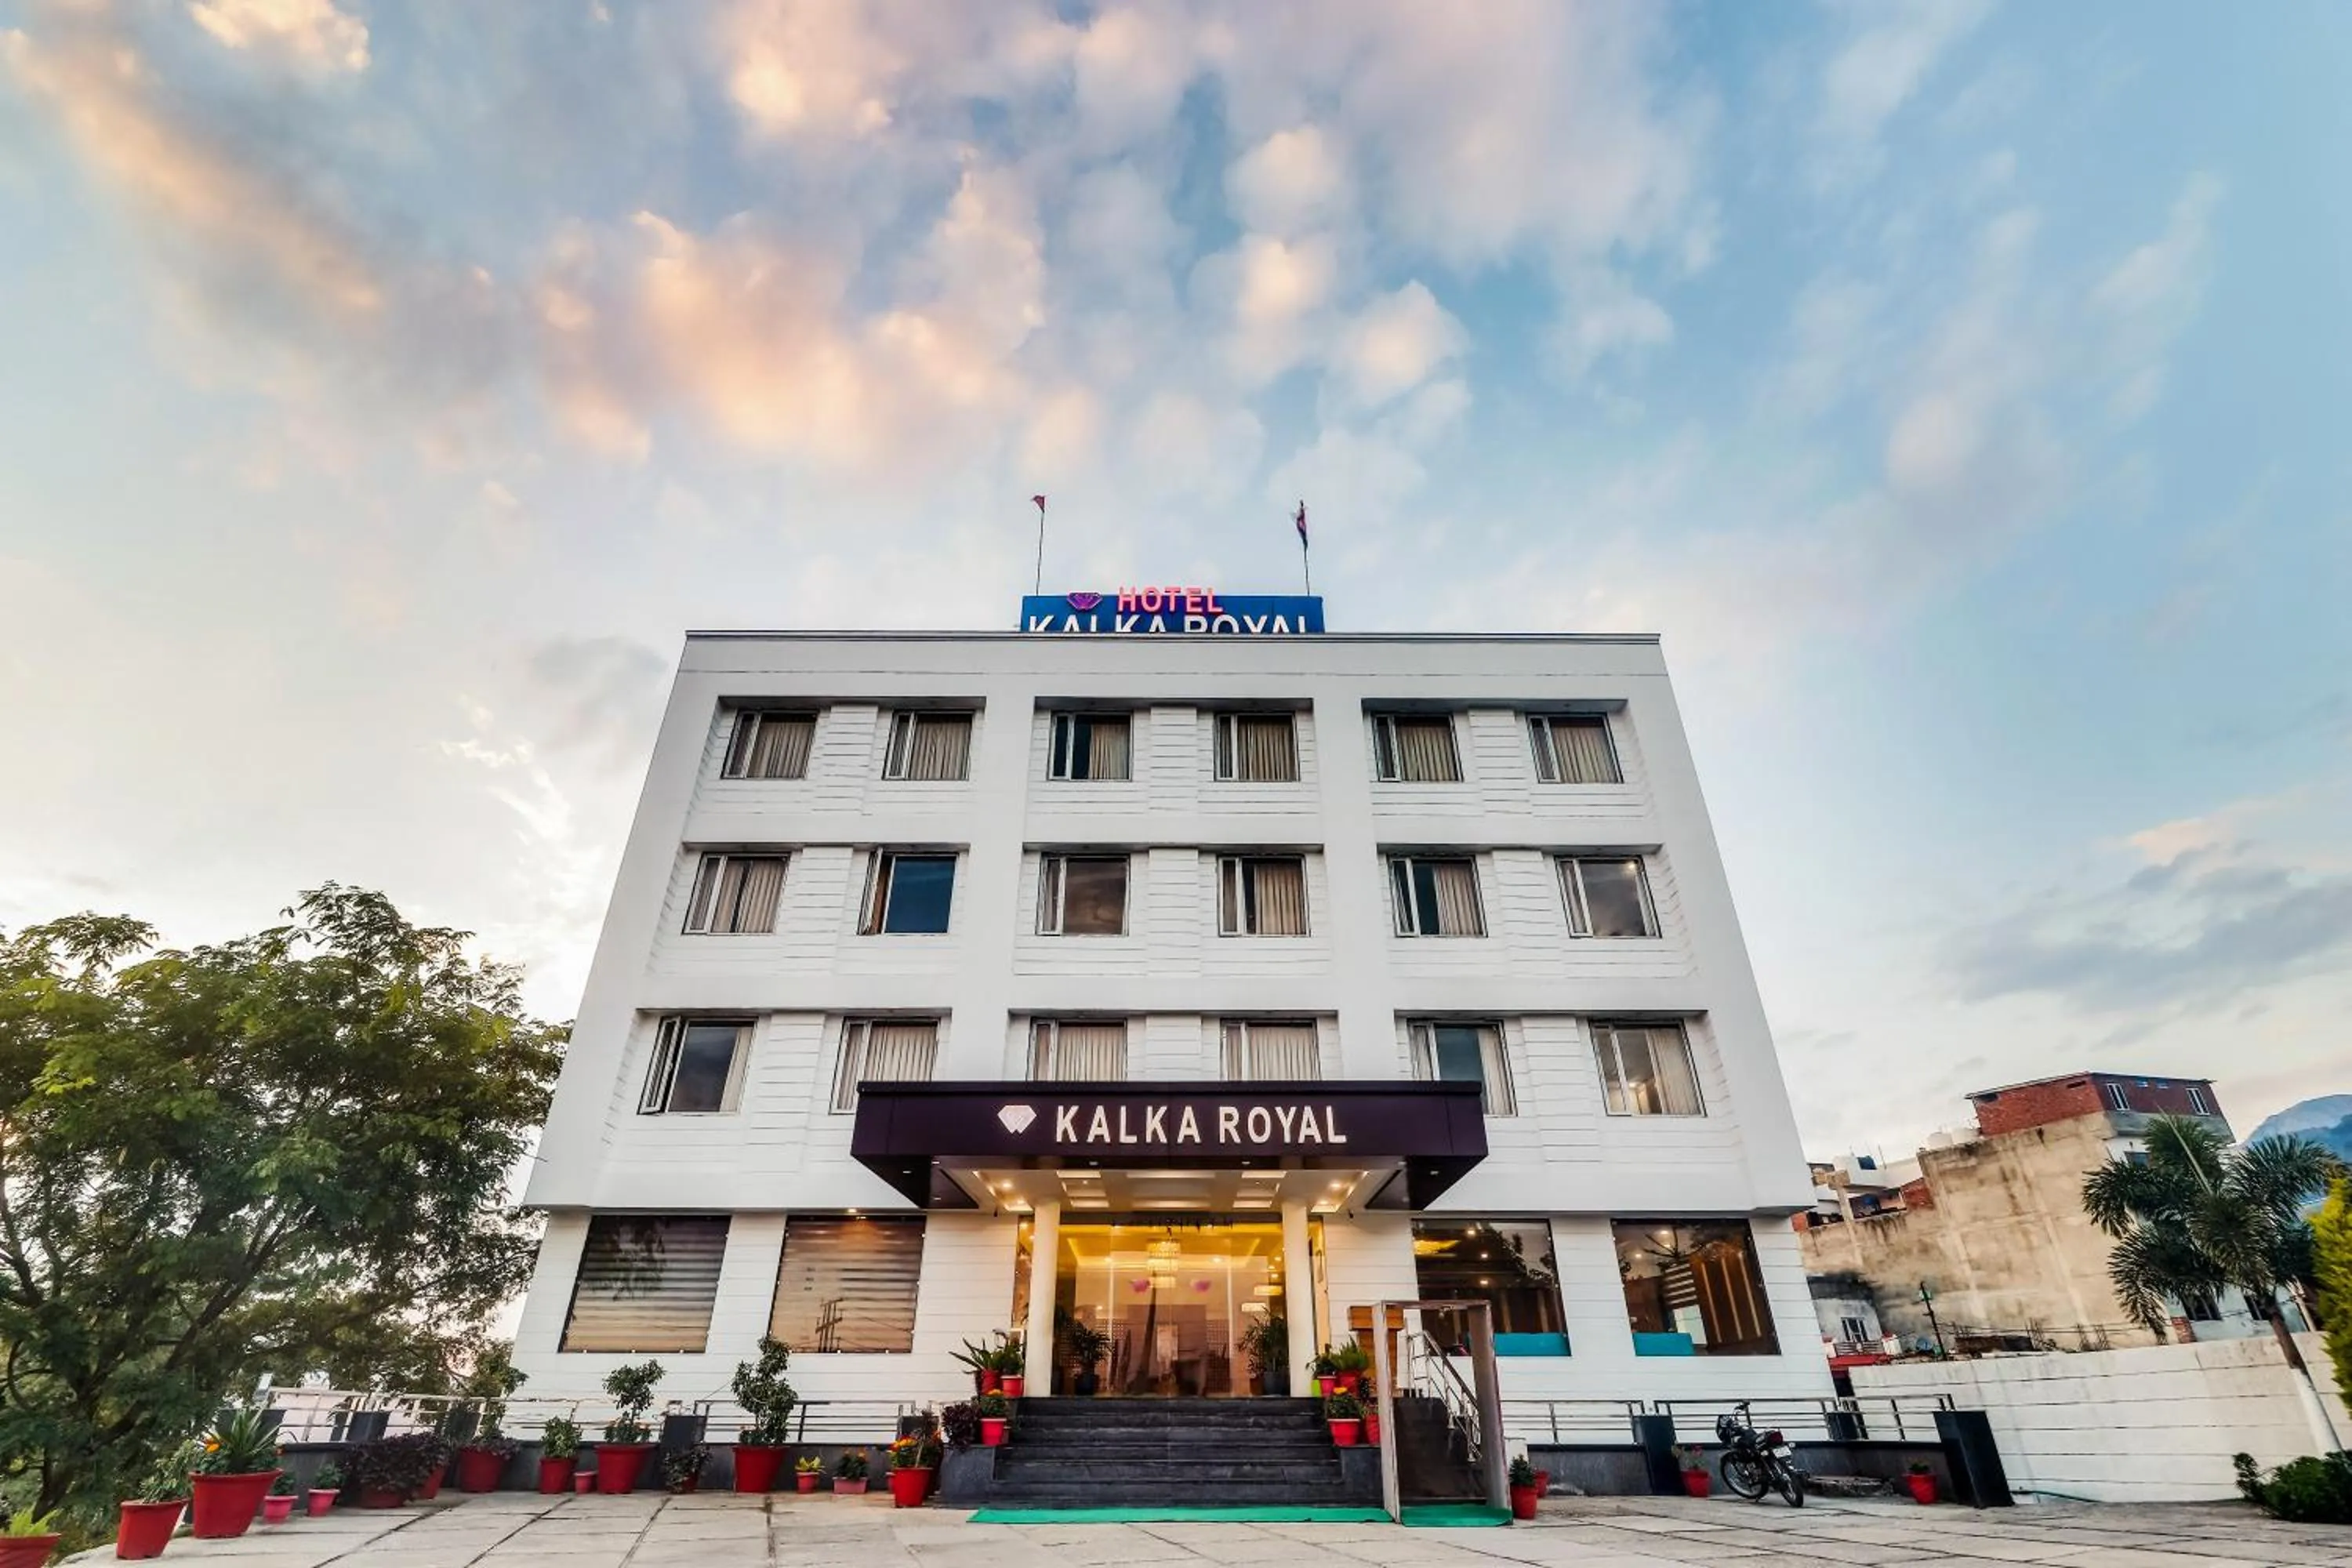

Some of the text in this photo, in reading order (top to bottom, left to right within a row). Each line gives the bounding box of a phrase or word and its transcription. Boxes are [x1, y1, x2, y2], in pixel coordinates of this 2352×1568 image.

[1117, 586, 1224, 612] HOTEL
[1055, 1105, 1347, 1144] KALKA ROYAL
